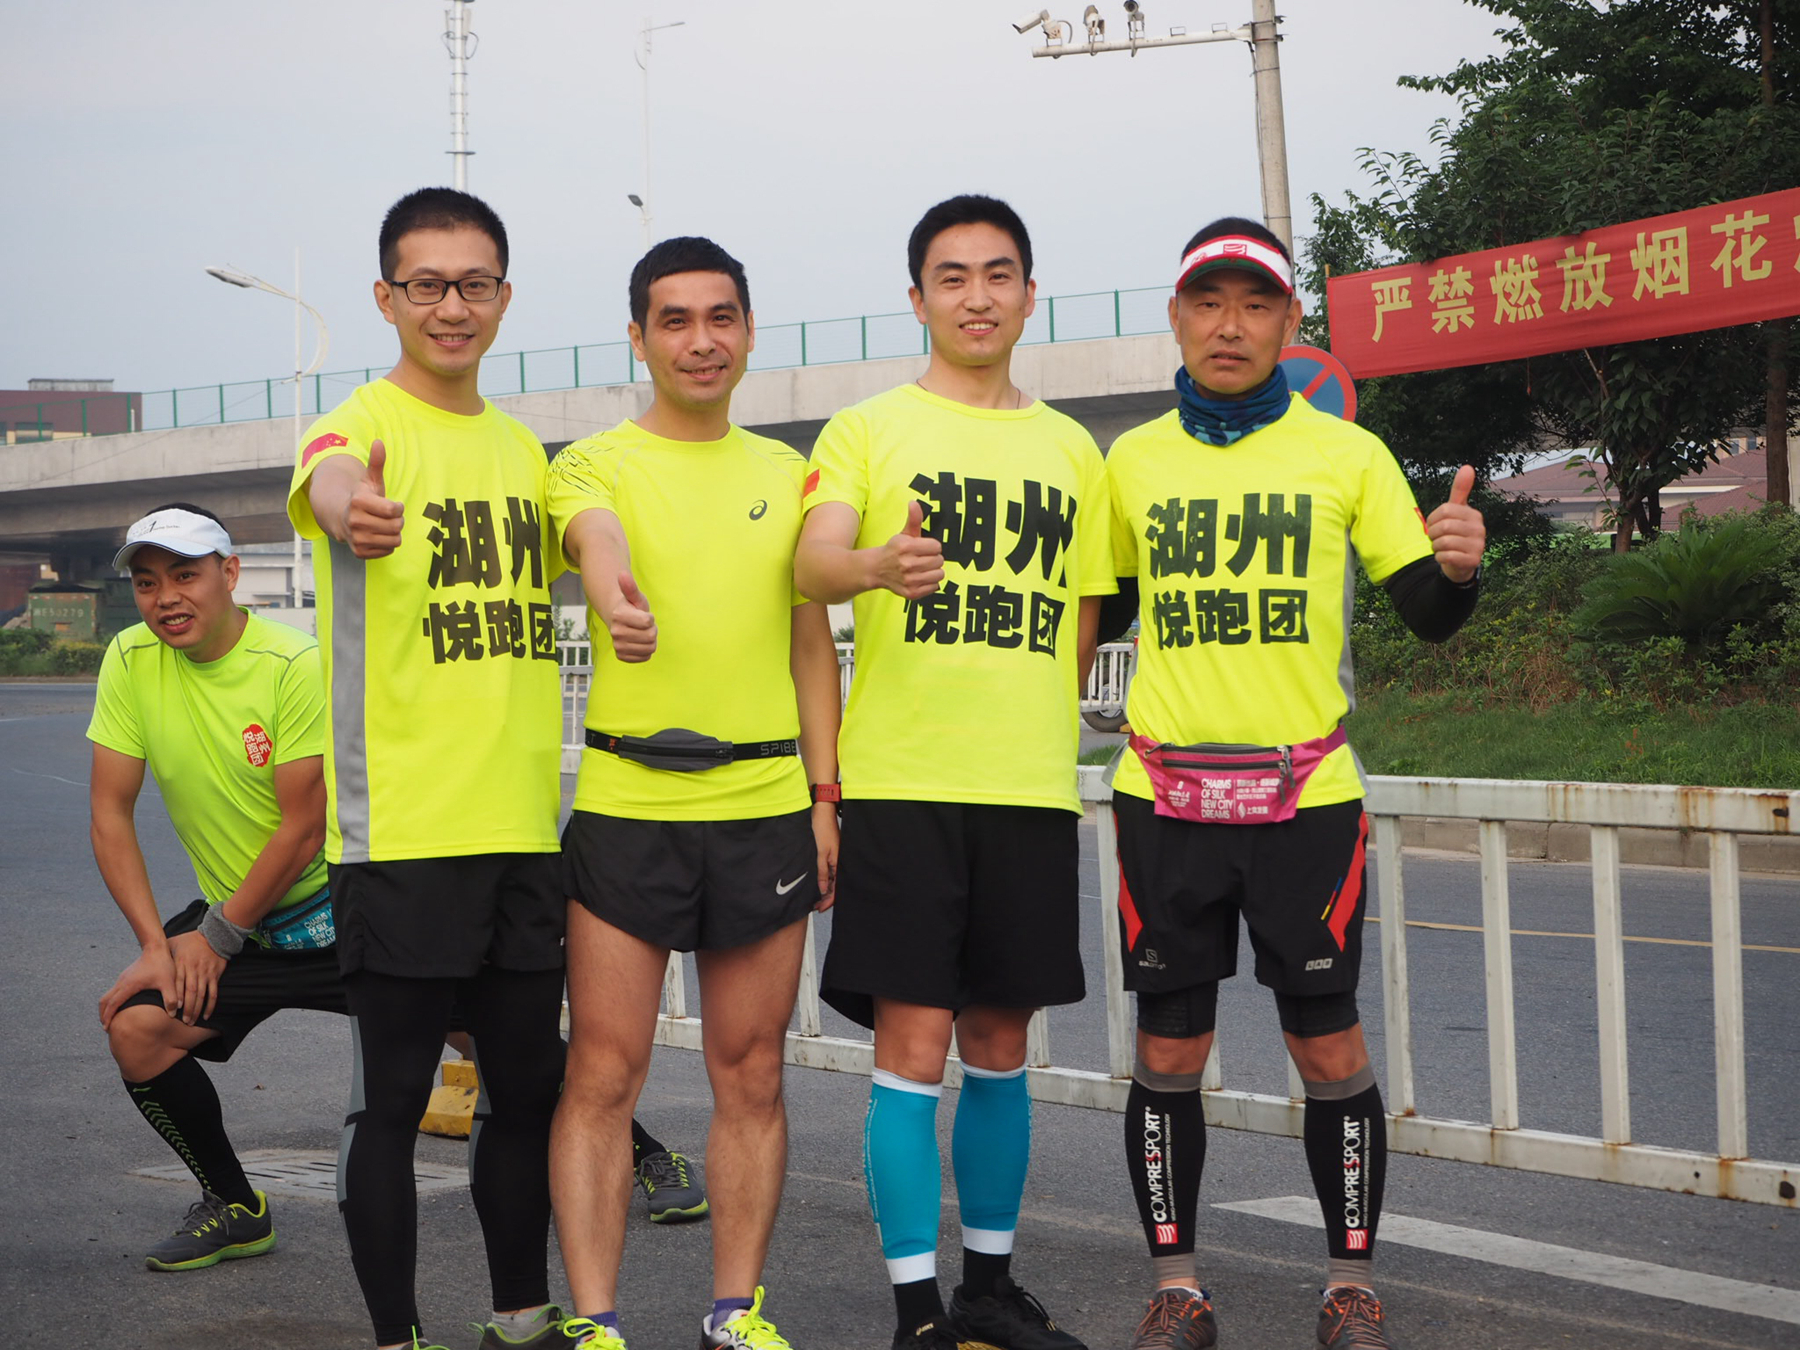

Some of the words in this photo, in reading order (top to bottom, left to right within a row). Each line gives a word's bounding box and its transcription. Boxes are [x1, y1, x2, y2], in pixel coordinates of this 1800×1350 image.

[1371, 209, 1800, 342] 严禁燃放烟花
[422, 496, 543, 590] 湖州
[909, 472, 1077, 588] 湖州
[1144, 492, 1312, 581] 湖州
[422, 598, 559, 664] 悦跑团
[904, 580, 1066, 660] 悦跑团
[1152, 588, 1309, 650] 悦跑团
[1201, 778, 1232, 789] CHARMS
[1201, 789, 1211, 799] OF
[1211, 789, 1226, 799] SILK
[1201, 799, 1217, 809] NEW
[1217, 799, 1233, 810] CITY
[1201, 809, 1230, 819] DREAMS
